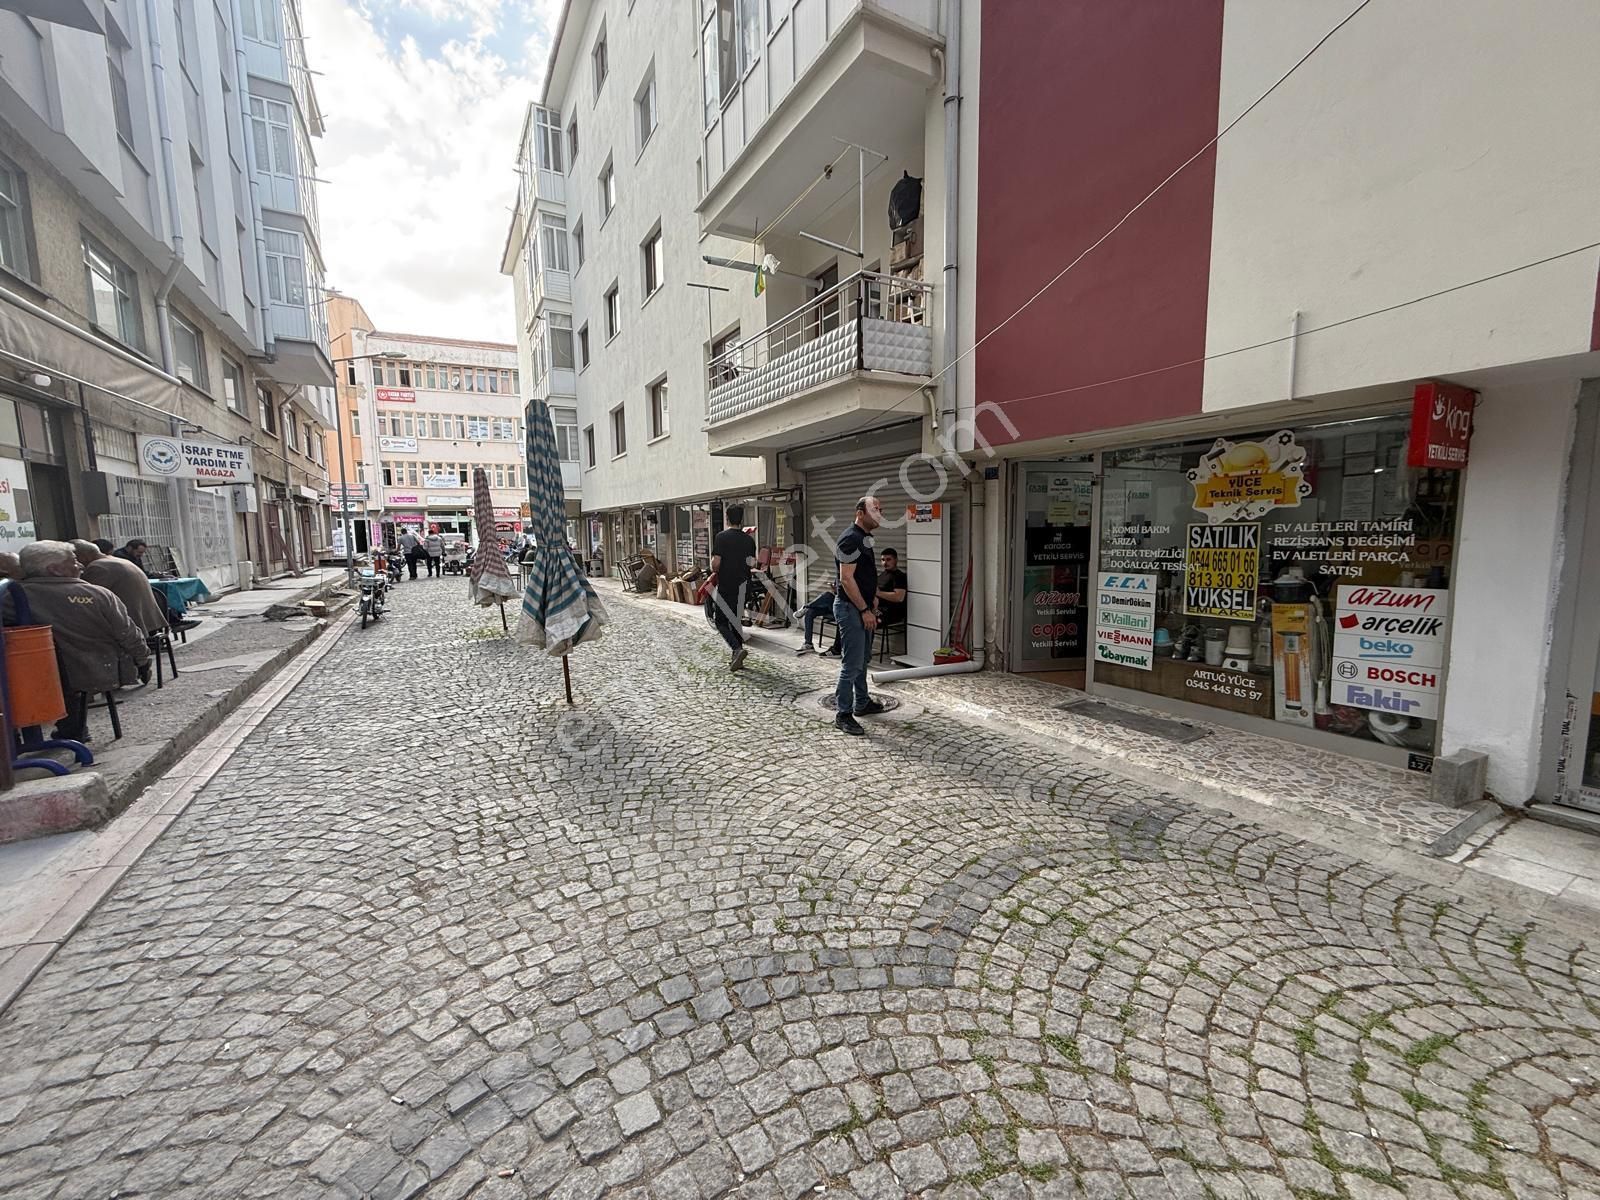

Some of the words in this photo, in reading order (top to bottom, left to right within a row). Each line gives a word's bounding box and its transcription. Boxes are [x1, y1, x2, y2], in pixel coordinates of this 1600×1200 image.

[1446, 398, 1470, 440] king
[181, 443, 213, 457] İSRAF
[216, 449, 244, 460] ETME
[186, 457, 227, 469] YARDIM
[230, 461, 242, 470] ET
[196, 467, 235, 478] MAĞAZA
[1228, 476, 1262, 488] YÜCE
[1209, 490, 1242, 499] Teknik
[1245, 486, 1283, 497] Servis
[1112, 524, 1140, 534] KOMBİ
[1141, 525, 1170, 534] BAKIM
[1274, 524, 1291, 532] EV
[1293, 520, 1358, 532] ALETLERİ
[1361, 519, 1413, 531] TAMİRİ
[1111, 537, 1137, 545] ARIZA
[1190, 526, 1257, 549] SATILIK
[1274, 535, 1345, 548] REZİSTANS
[1347, 534, 1415, 548] DEĞİŞİMİ
[1033, 552, 1059, 561] YETKİLİ
[1060, 552, 1084, 560] SERVİS
[1111, 549, 1138, 558] PETEK
[1140, 548, 1185, 559] TEMİZLİĞİ
[1273, 551, 1290, 560] EV
[1293, 550, 1356, 561] ALETLERİ
[1359, 551, 1409, 564] PARÇA
[1110, 559, 1160, 571] DOĞALGAZ
[1190, 550, 1210, 572] 0544
[1212, 551, 1228, 573] 665
[1230, 551, 1240, 573] 01
[1243, 551, 1255, 574] 66
[1318, 565, 1363, 578] SATIŞI
[1189, 572, 1213, 588] 813
[1216, 573, 1233, 588] 30
[1237, 574, 1254, 589] 30
[1034, 590, 1081, 607] arzum
[1112, 596, 1152, 609] DemirDöküm
[1187, 586, 1253, 610] YÜKSEL
[1347, 588, 1435, 613] arzum
[1036, 608, 1056, 616] Yetkili
[1111, 613, 1148, 628] Vaillant
[1361, 616, 1443, 636] arçelik
[1031, 623, 1078, 639] copa
[1031, 640, 1053, 648] Yetkili
[1359, 637, 1414, 654] beko
[1109, 650, 1148, 666] baymak
[1193, 669, 1226, 683] ARTUĞ
[1228, 674, 1256, 689] YÜCE
[1367, 667, 1437, 687] BOSCH
[1185, 678, 1210, 691] 0545
[1211, 683, 1231, 695] 445
[1233, 687, 1247, 698] 85
[1248, 691, 1263, 701] 97
[1346, 685, 1421, 712] Fakir
